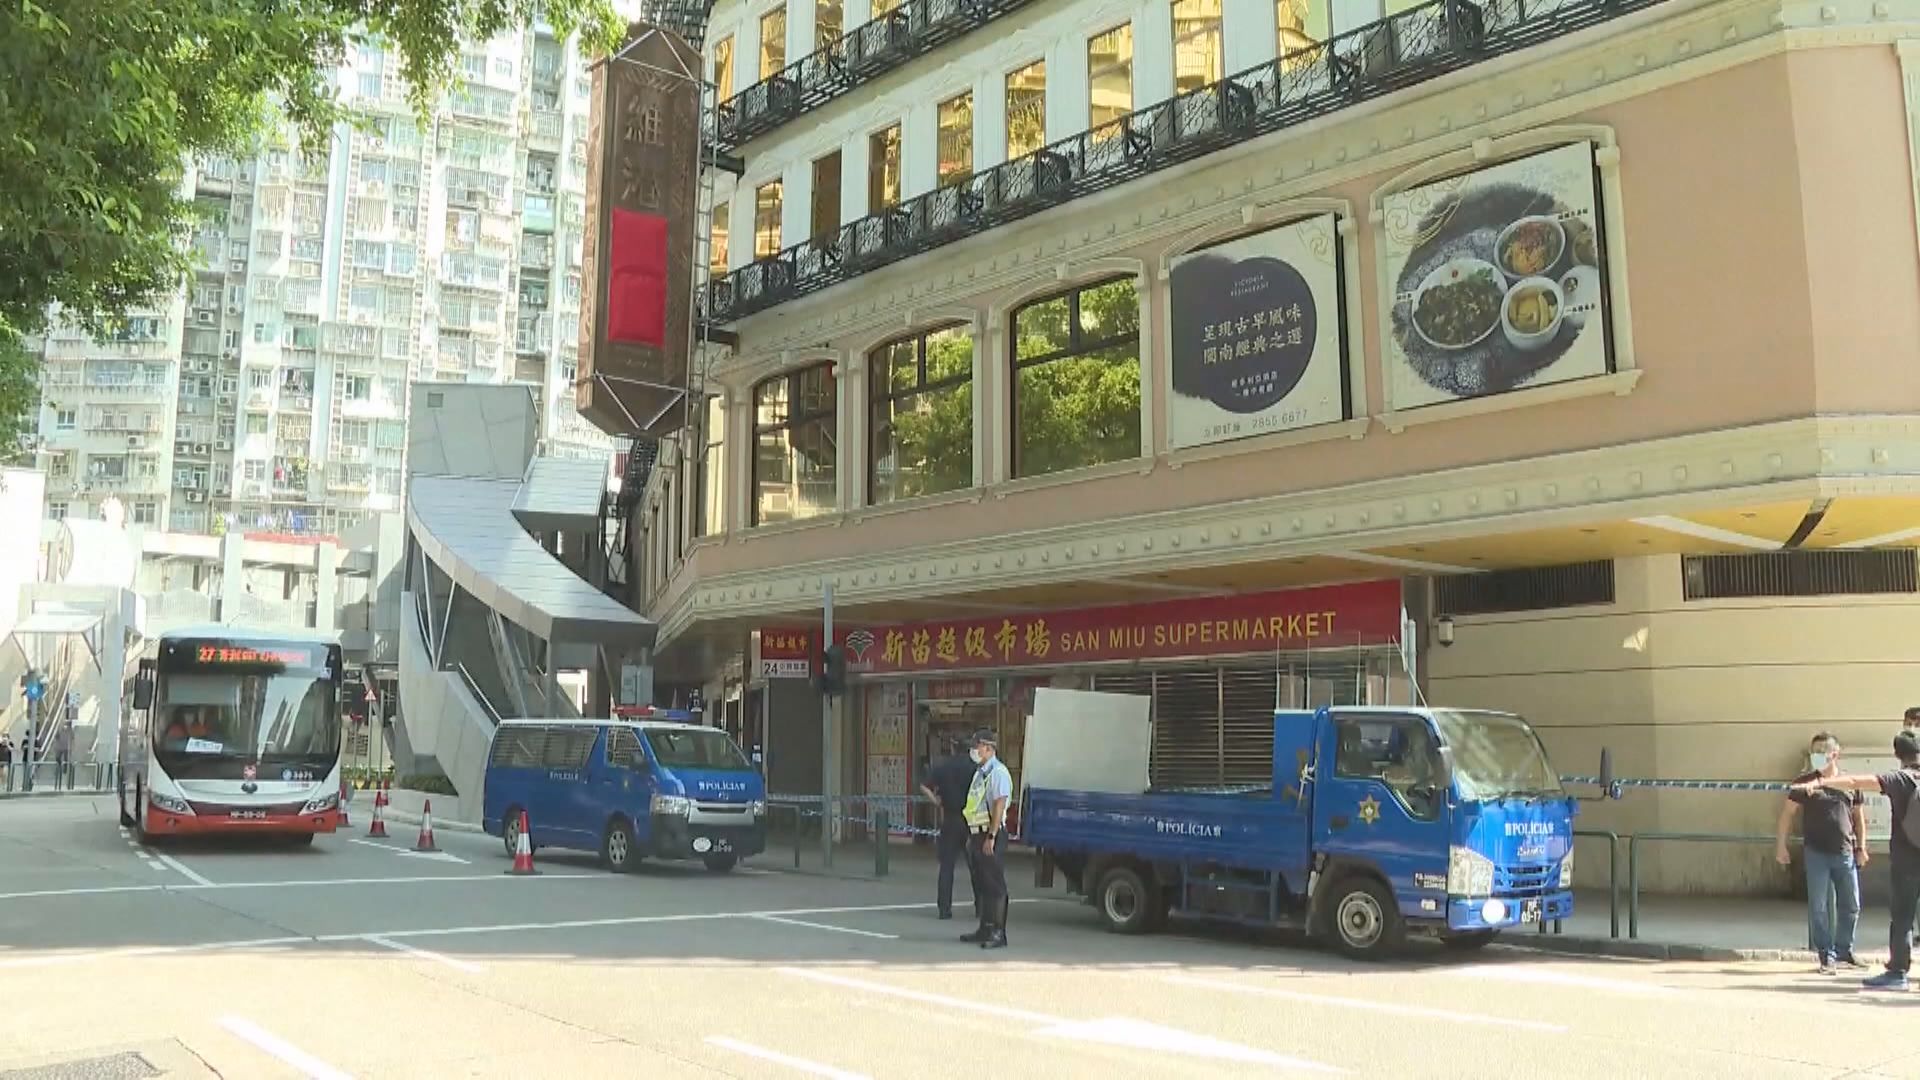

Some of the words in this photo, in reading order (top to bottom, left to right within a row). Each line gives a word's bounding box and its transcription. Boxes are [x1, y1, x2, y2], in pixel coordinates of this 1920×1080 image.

[1061, 630, 1100, 652] SAN
[1109, 627, 1145, 649] MIU
[1154, 611, 1337, 646] SUPERMARKET
[199, 647, 215, 662] 27
[764, 663, 777, 675] 24
